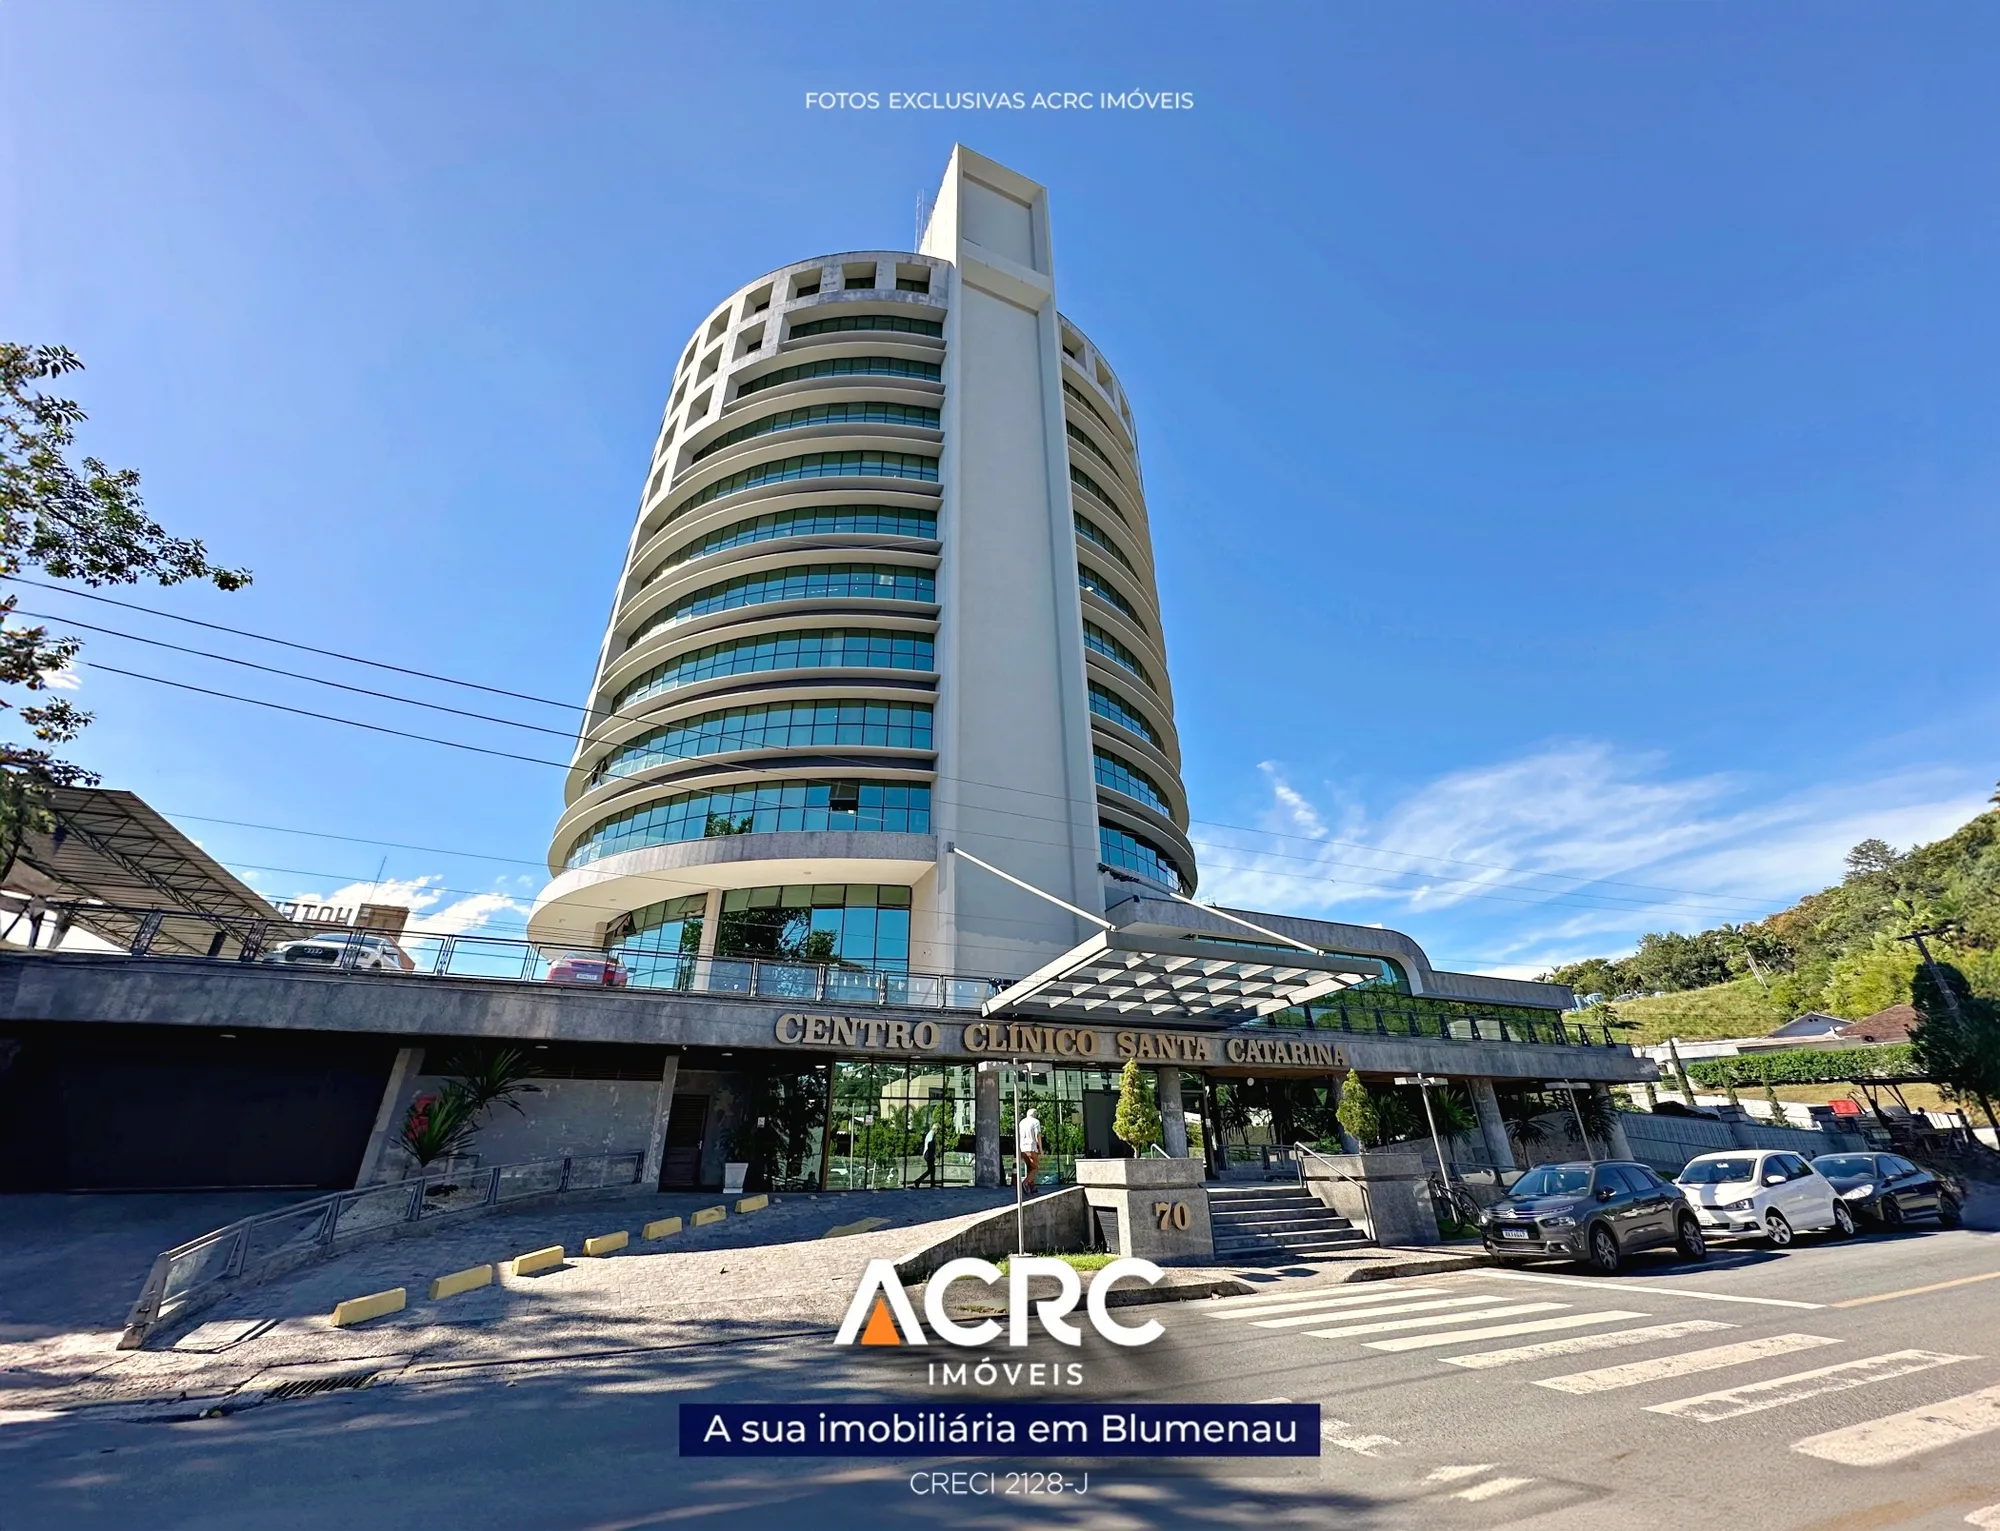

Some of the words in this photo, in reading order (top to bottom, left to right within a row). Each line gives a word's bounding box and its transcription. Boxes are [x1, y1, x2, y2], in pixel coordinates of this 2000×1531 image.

[775, 1013, 941, 1050] CENTRO
[963, 1022, 1099, 1057] CLÍNICO
[1116, 1031, 1212, 1061] SANTA
[1227, 1038, 1350, 1066] CATARINA
[1153, 1201, 1191, 1231] 70
